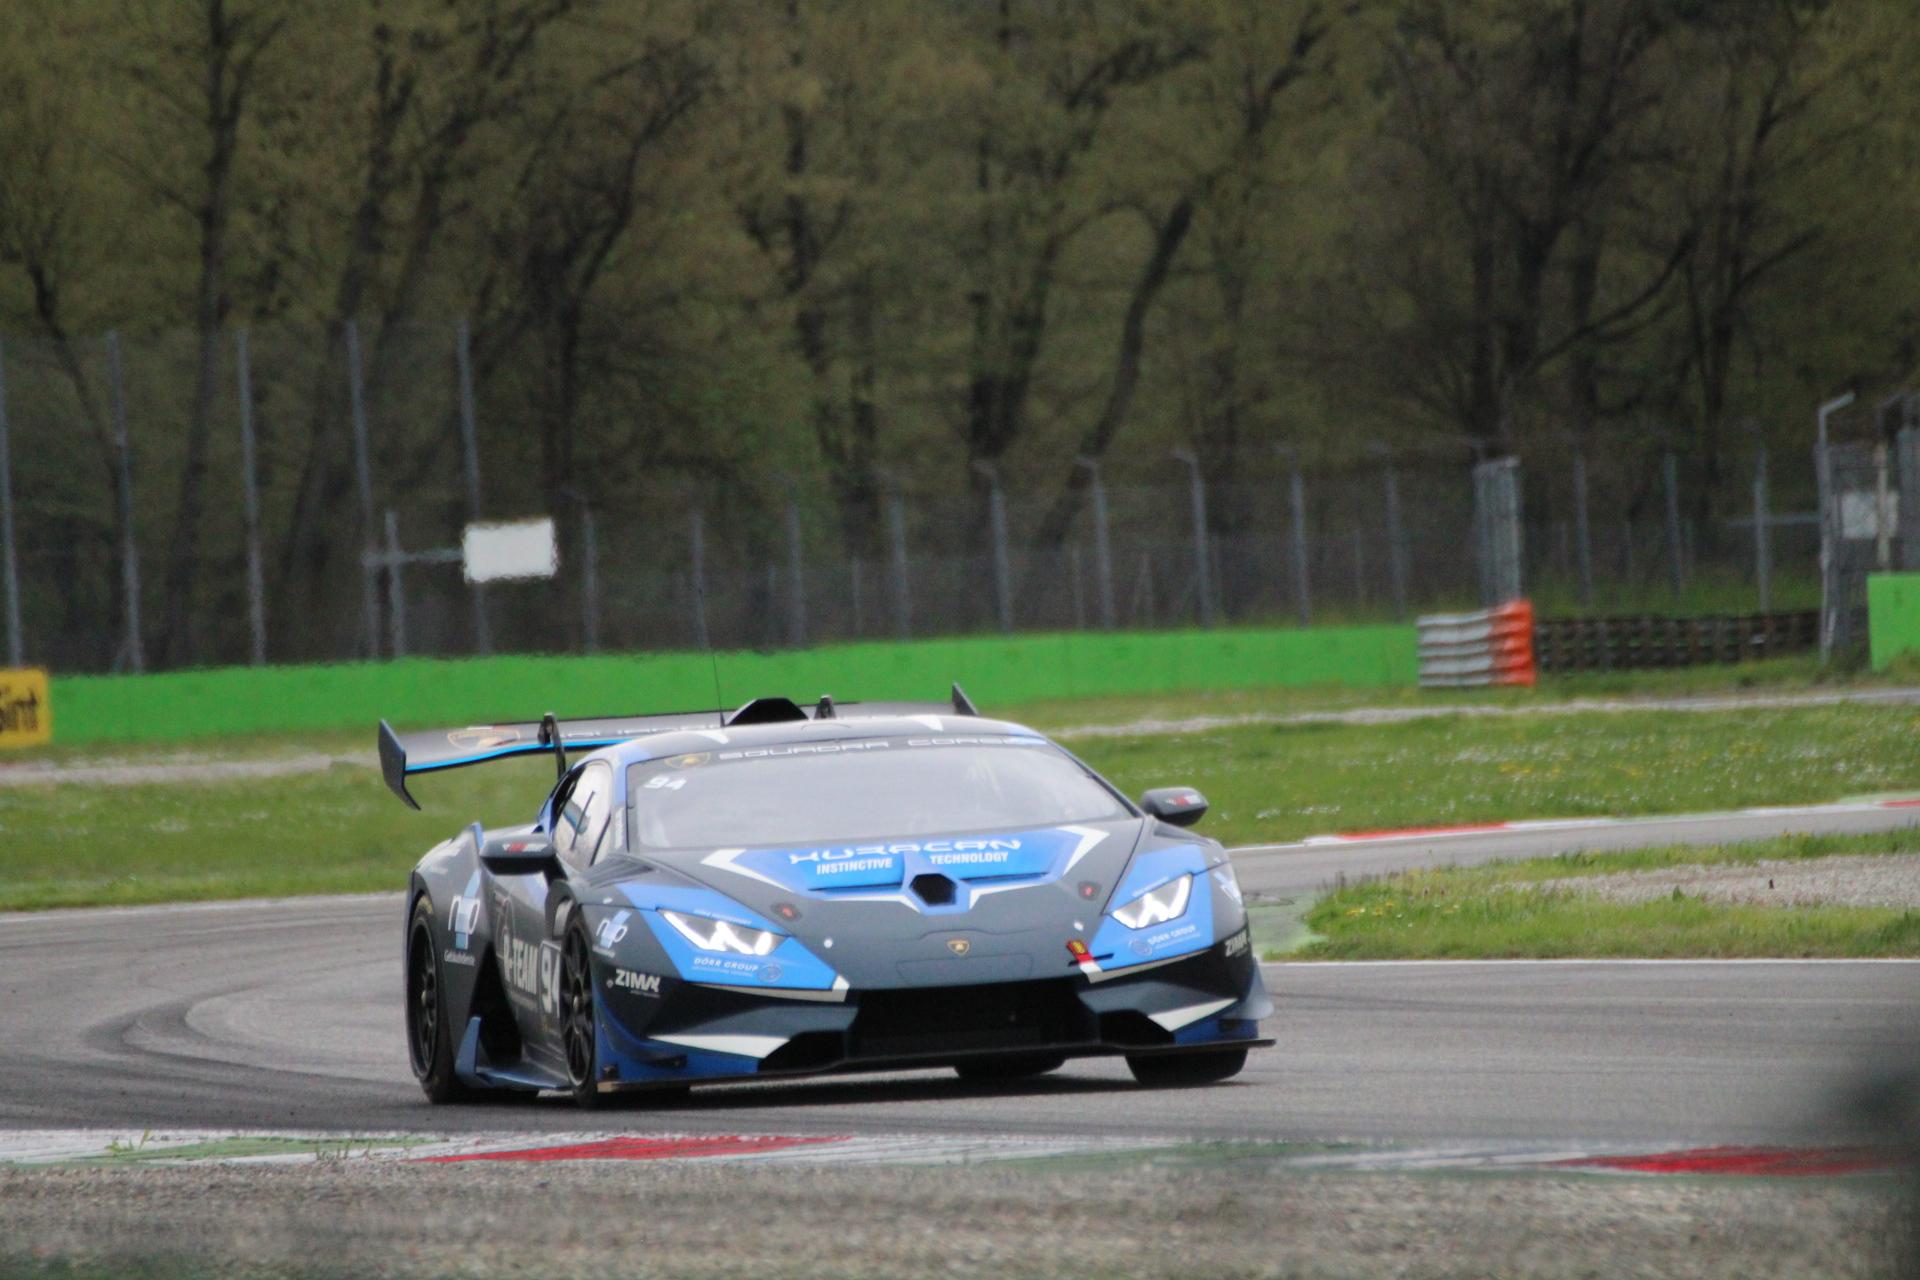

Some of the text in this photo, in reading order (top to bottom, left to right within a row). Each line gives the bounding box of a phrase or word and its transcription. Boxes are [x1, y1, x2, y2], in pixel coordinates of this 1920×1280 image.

[718, 741, 890, 761] SQUADRA
[643, 776, 687, 791] 94
[816, 858, 893, 875] INSTINCTIVE
[930, 852, 1009, 866] TECHNOLOGY
[694, 957, 722, 967] DÖRR
[724, 961, 759, 972] GROUP
